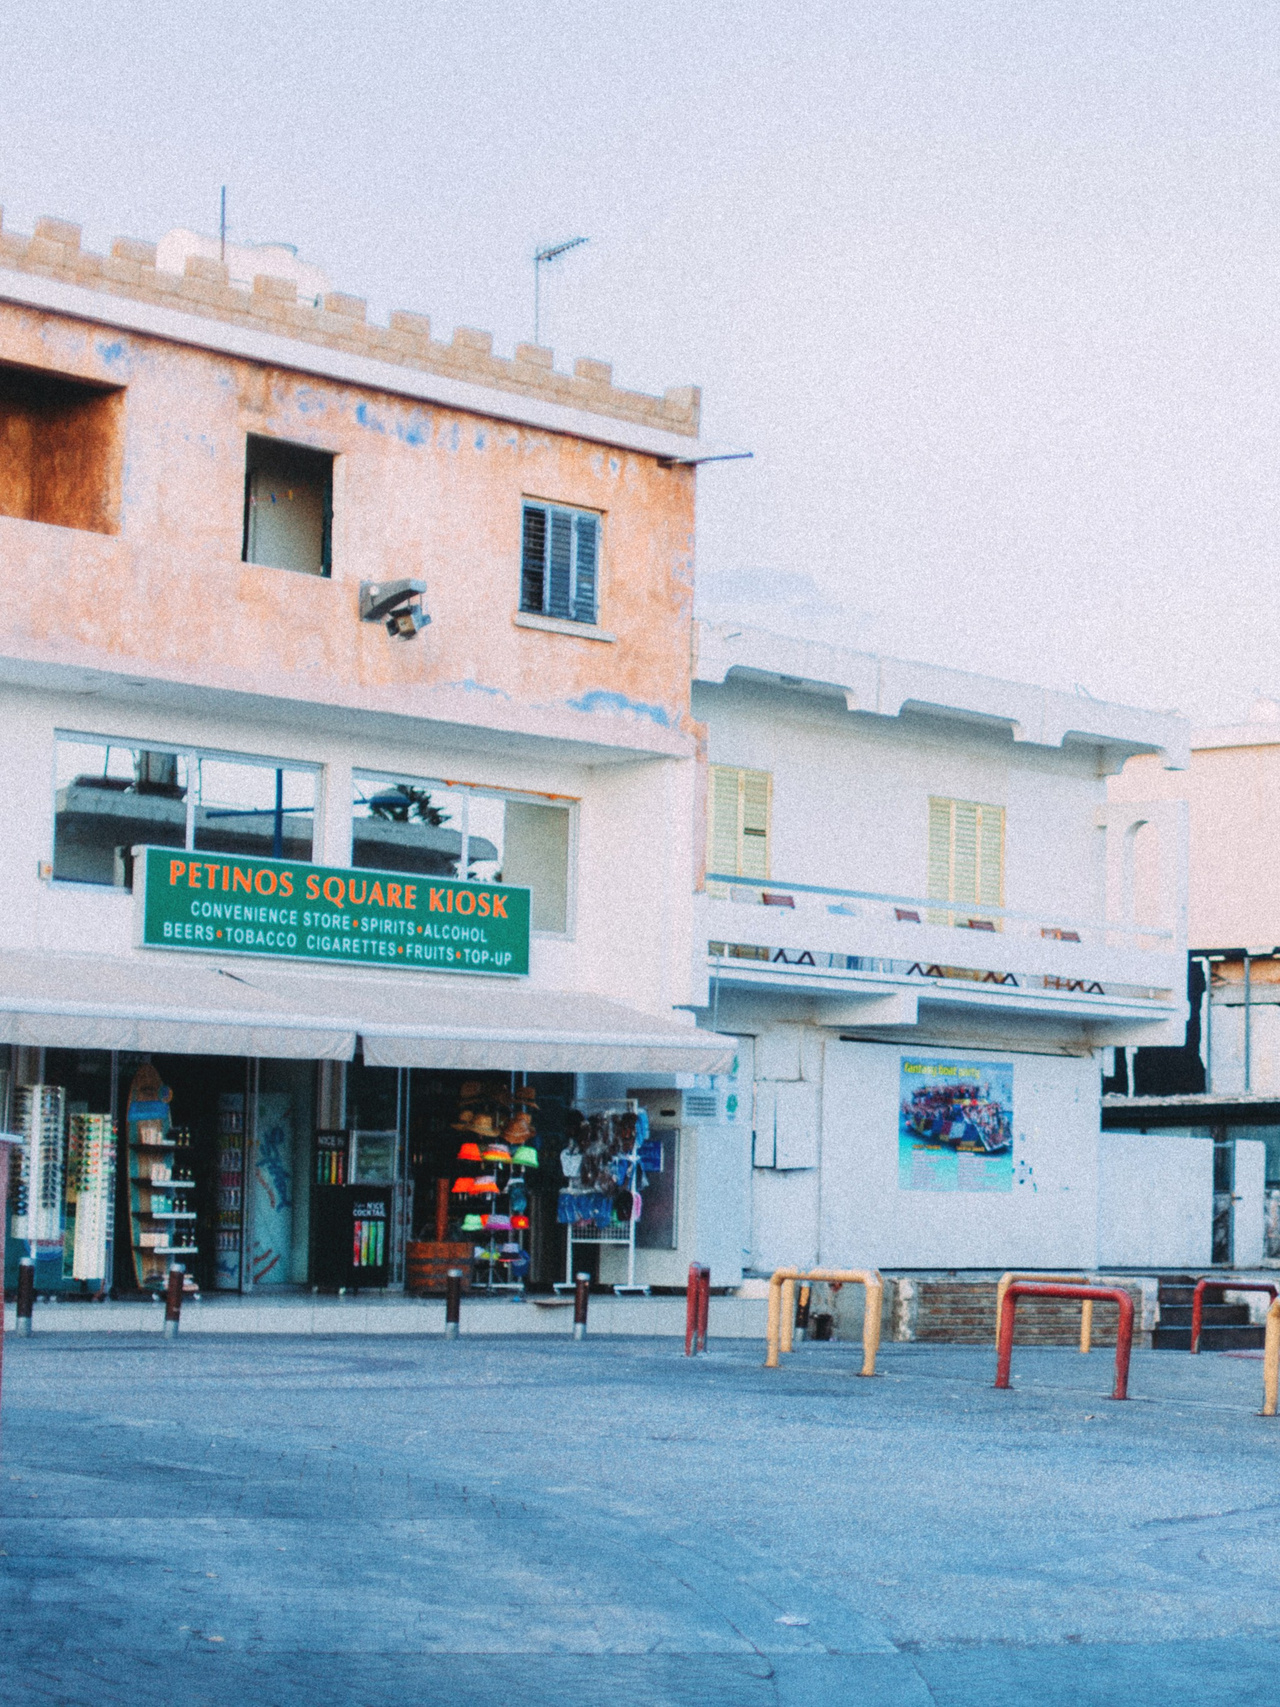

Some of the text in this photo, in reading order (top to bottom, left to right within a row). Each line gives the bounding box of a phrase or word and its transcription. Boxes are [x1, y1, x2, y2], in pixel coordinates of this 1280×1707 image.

[169, 859, 509, 919] PETINOS SQUARE KIOSK
[163, 922, 513, 967] BEERS TOBACCO CIGARETTES FRUITS TOP-UP
[190, 901, 488, 943] CONVENIENCE STORE SPIRITS ALCOHOL
